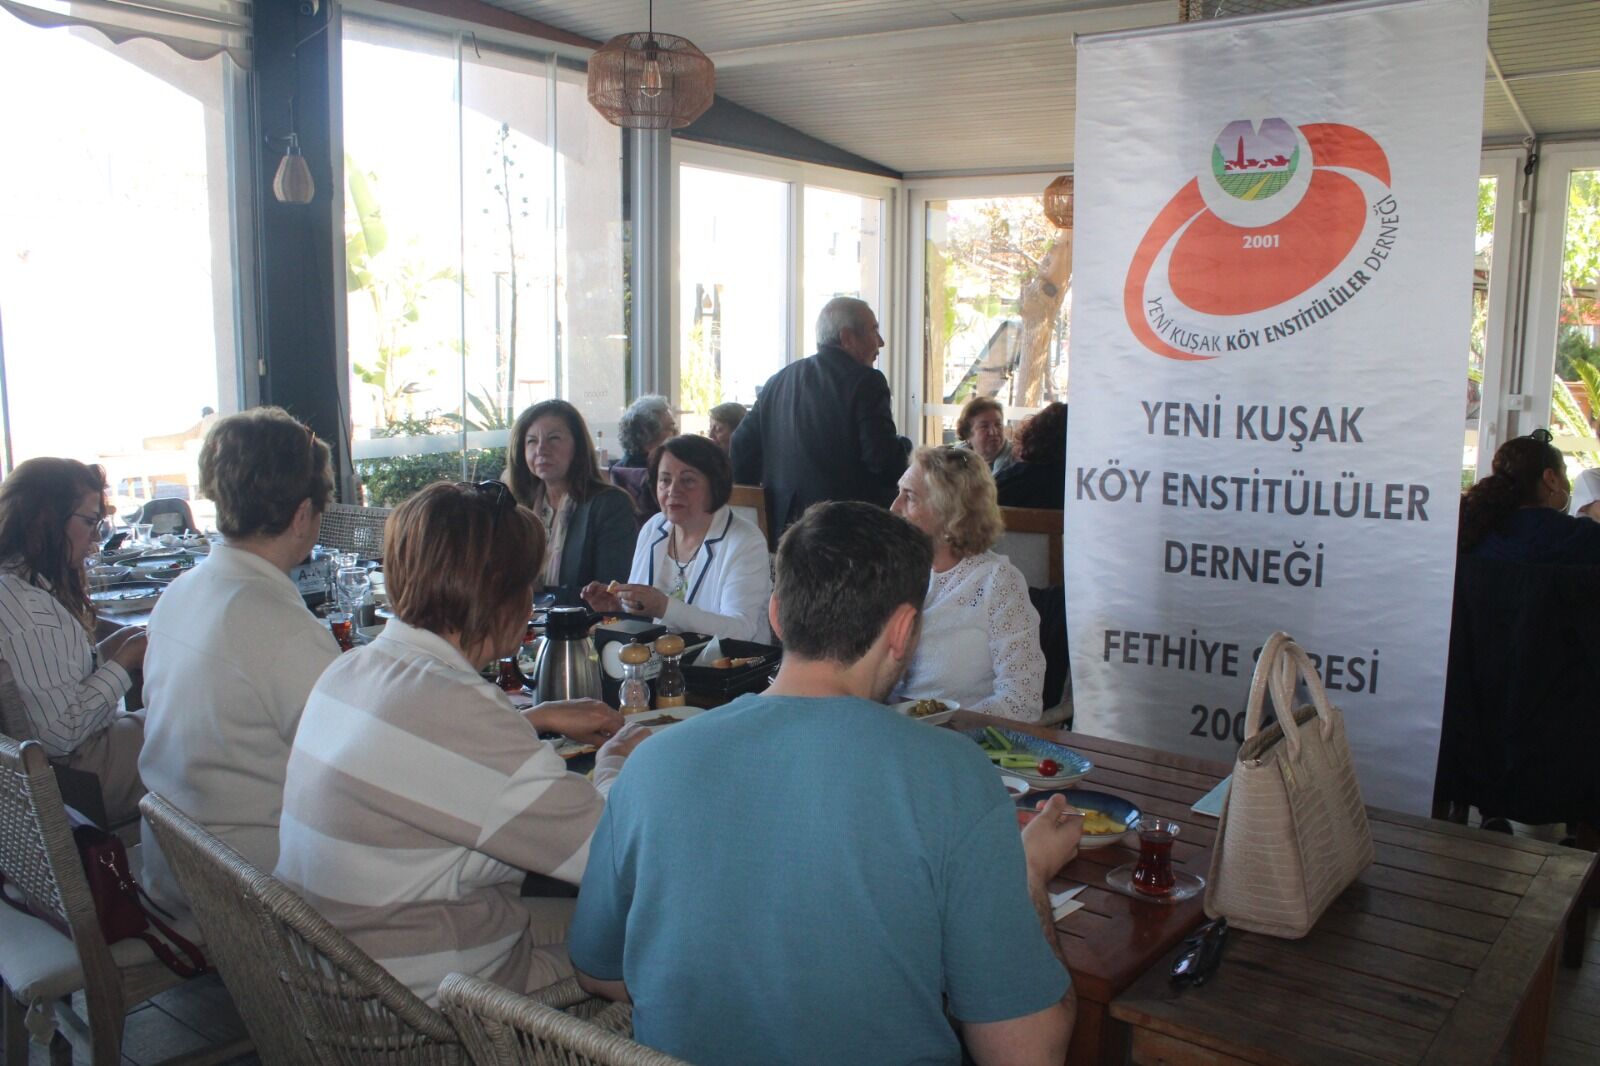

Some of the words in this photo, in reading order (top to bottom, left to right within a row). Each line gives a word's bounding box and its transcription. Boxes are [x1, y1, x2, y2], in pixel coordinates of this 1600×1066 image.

[1242, 234, 1280, 249] 2001
[1147, 296, 1174, 334] YENİ
[1169, 326, 1221, 353] KUŞAK
[1226, 329, 1260, 351] KÖY
[1264, 270, 1371, 343] ENSTİTÜLÜLER
[1362, 194, 1399, 272] DERNEĞİ
[1141, 394, 1221, 438] YENİ
[1236, 405, 1365, 452] KUŞAK
[1076, 459, 1151, 503] KÖY
[1162, 467, 1430, 521] ENSTİTÜLÜLER
[1164, 540, 1324, 588] DERNEĞİ
[1103, 629, 1239, 677] FETHİYE
[1252, 646, 1379, 694] BESİ
[1189, 704, 1274, 745] 200
